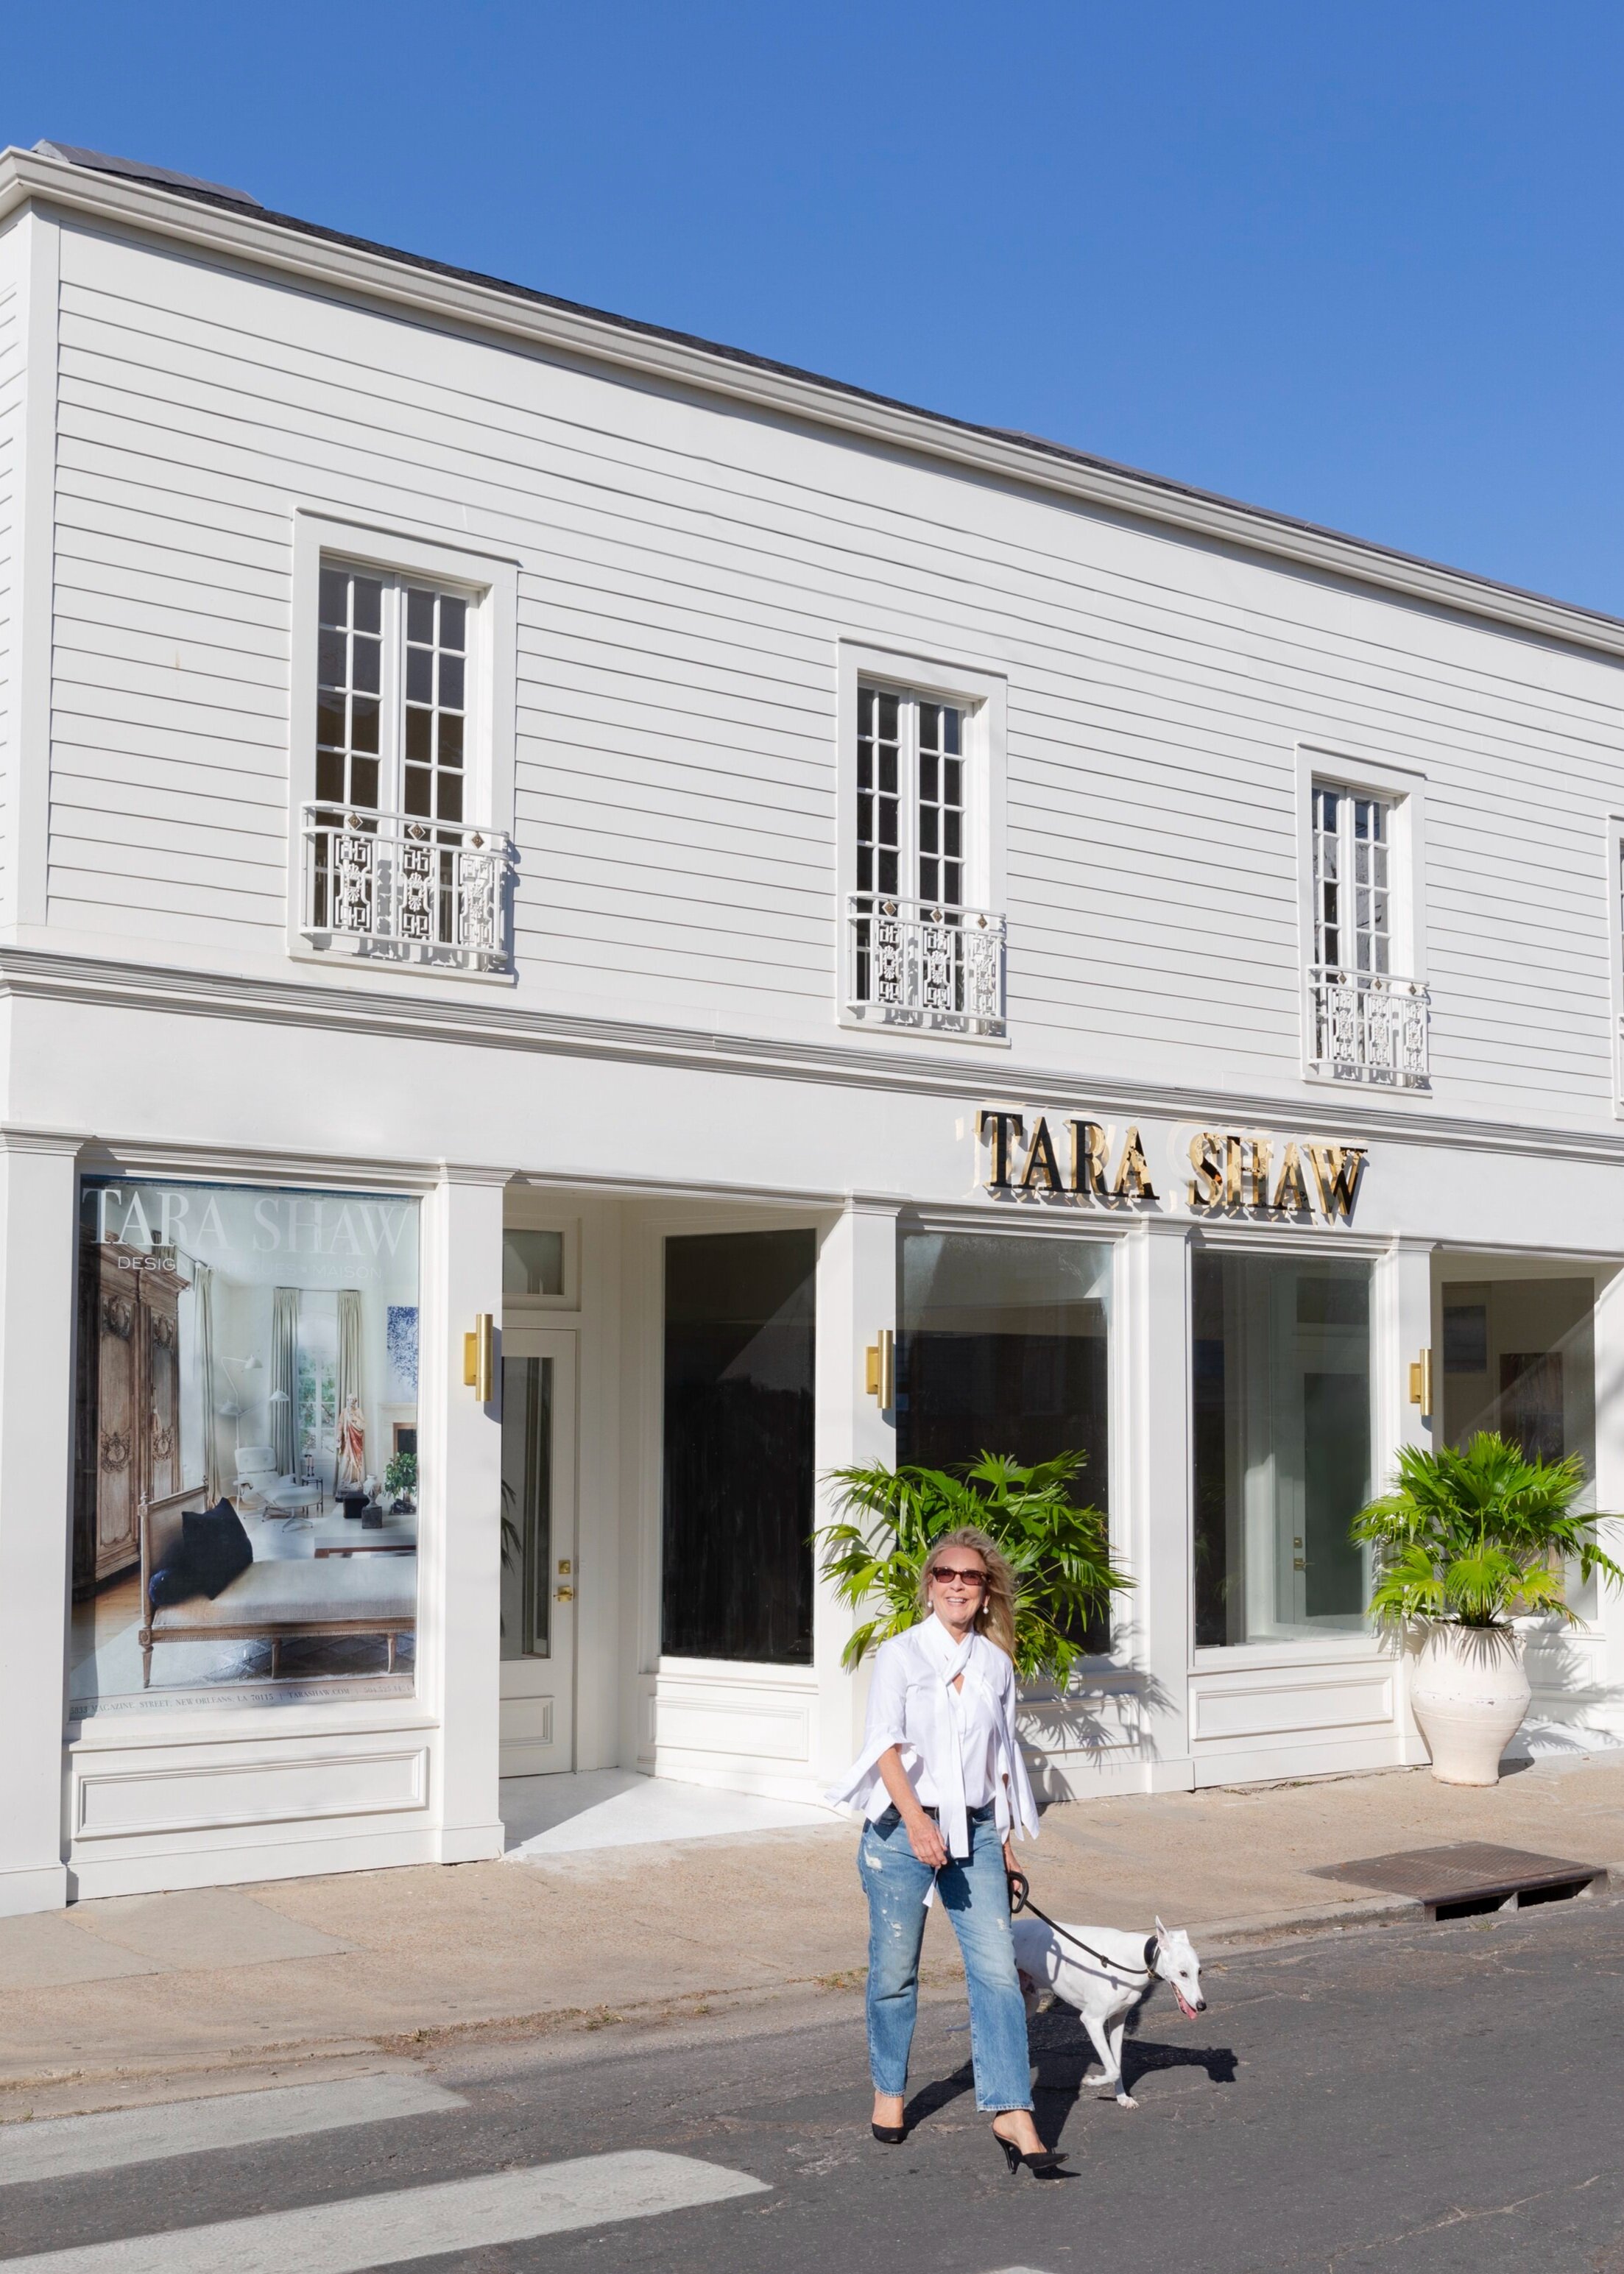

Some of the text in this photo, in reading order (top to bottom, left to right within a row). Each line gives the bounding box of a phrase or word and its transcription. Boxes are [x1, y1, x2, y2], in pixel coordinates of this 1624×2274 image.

[975, 1110, 1368, 1216] TARA SHAW
[82, 1188, 413, 1258] TARA SHAW
[118, 1255, 190, 1272] DESIGN
[313, 1265, 381, 1279] MAISON
[70, 1706, 88, 1715] 5833
[92, 1701, 135, 1712] MAGAZINE
[175, 1698, 193, 1706] NEW
[250, 1693, 274, 1701] 70115
